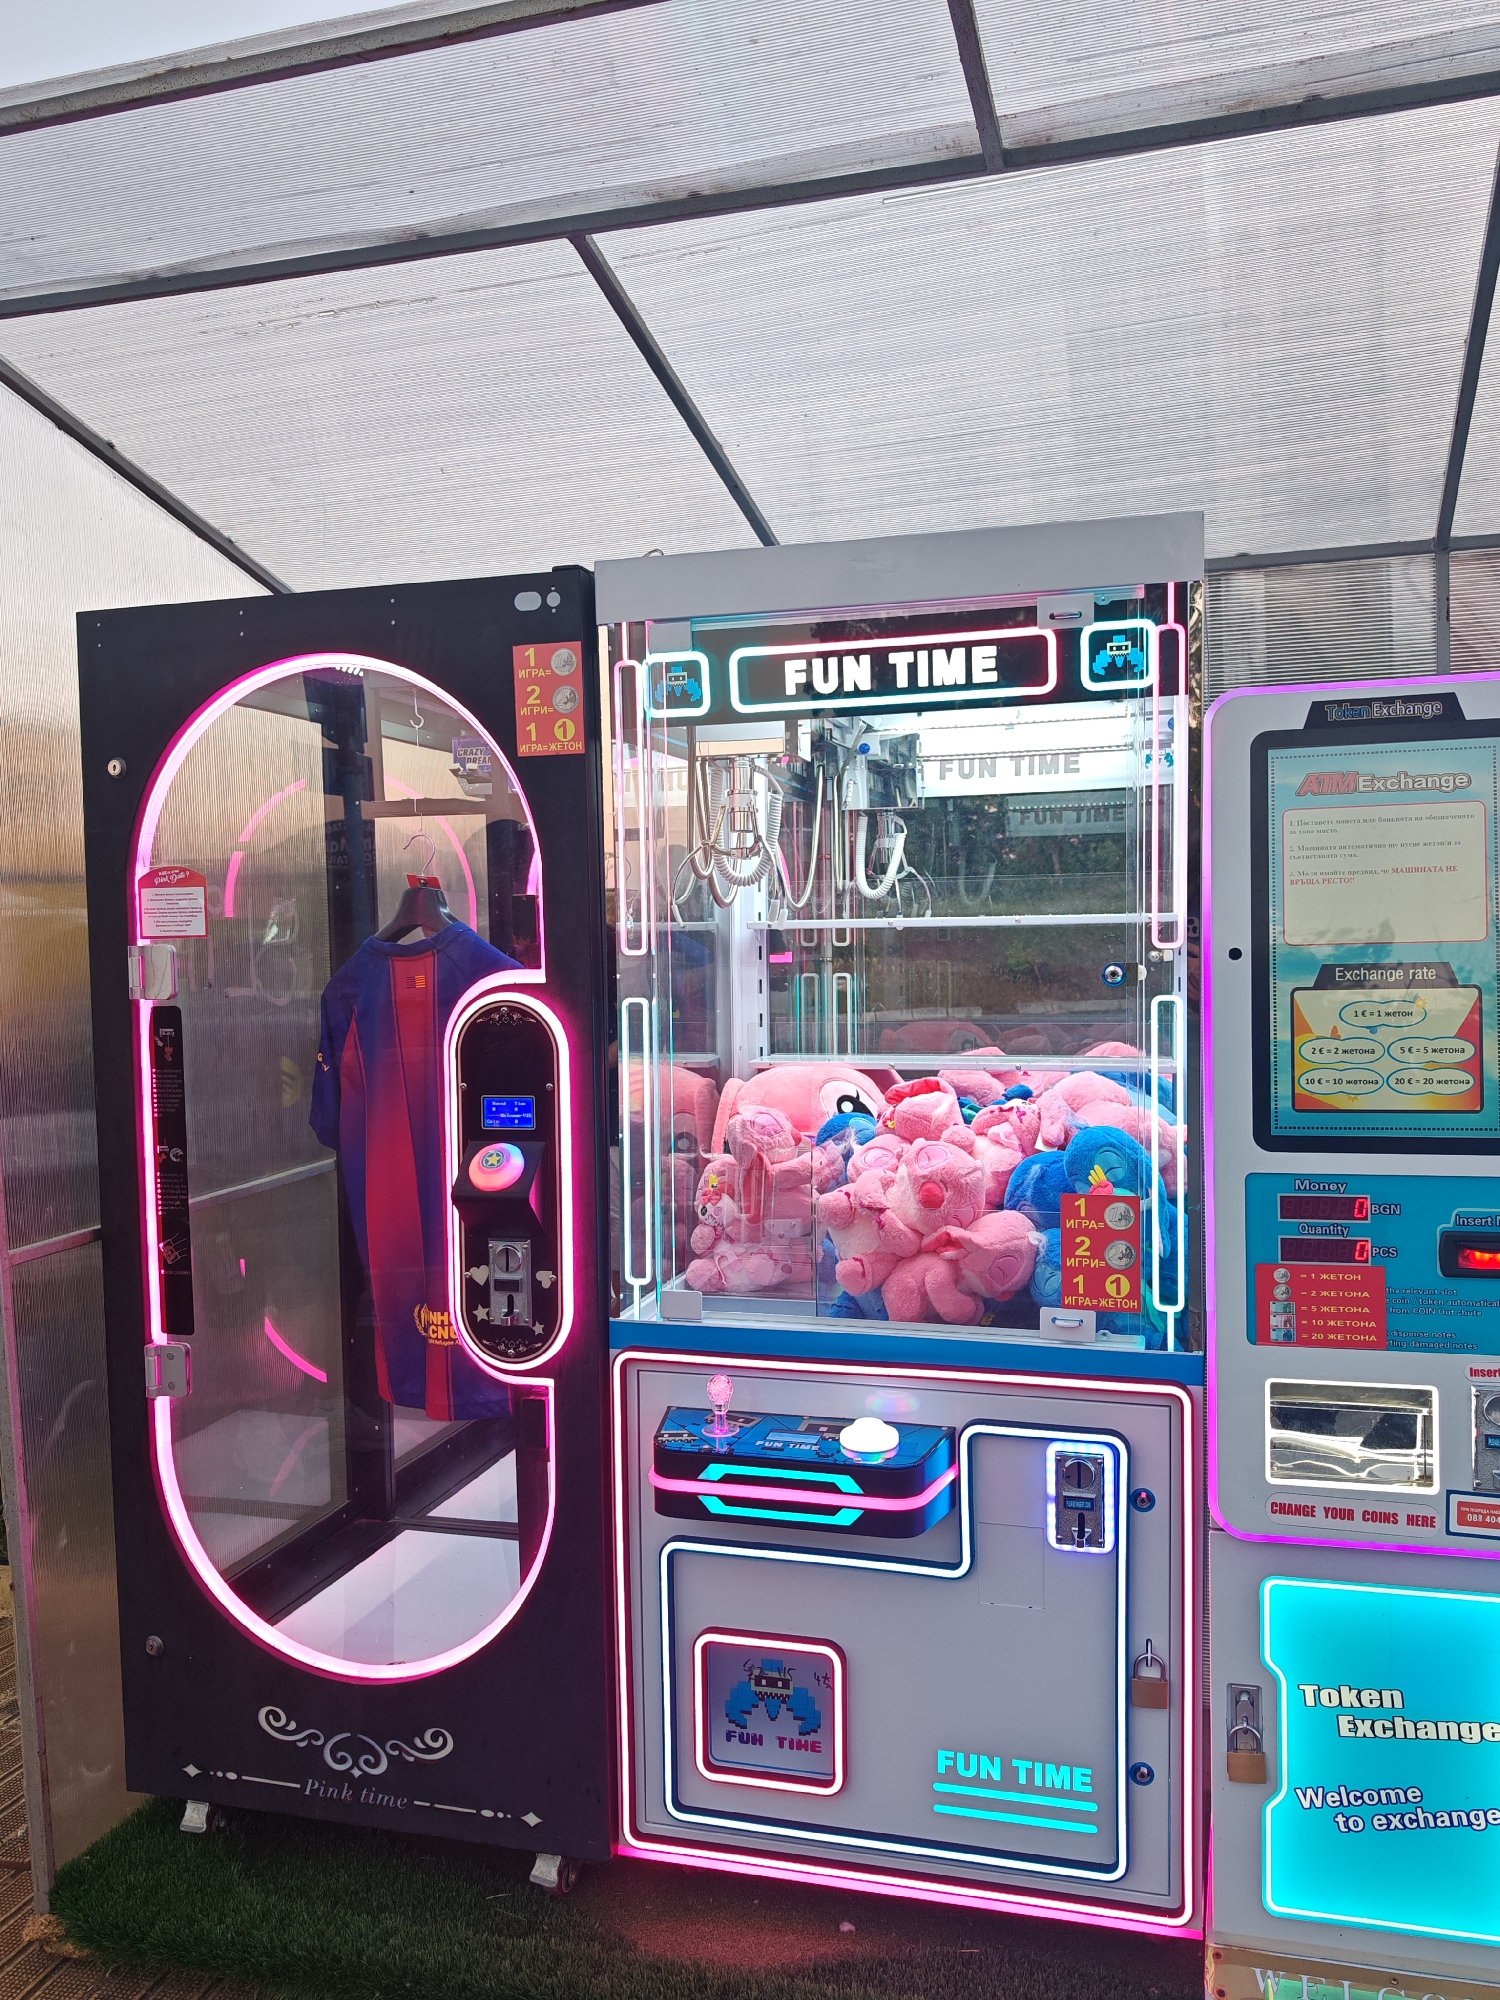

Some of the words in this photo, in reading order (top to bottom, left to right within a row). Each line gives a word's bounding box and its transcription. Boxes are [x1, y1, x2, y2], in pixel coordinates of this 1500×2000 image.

[524, 648, 535, 667] 1
[784, 654, 872, 696] FUN
[888, 645, 998, 689] TIME
[526, 685, 541, 705] 2
[1325, 703, 1371, 721] Token
[1372, 700, 1443, 719] Exchange
[526, 722, 537, 742] 1
[557, 720, 568, 741] 1
[457, 747, 485, 757] CRAZY
[939, 757, 997, 780] FUN
[1010, 753, 1080, 776] TIME
[1019, 809, 1063, 826] FUN
[1070, 807, 1125, 823] TIME
[1391, 866, 1443, 874] МАШИНАТА
[1290, 878, 1320, 886] ВРЪЩА
[1335, 967, 1404, 982] Exchange
[1409, 966, 1437, 980] rate
[1353, 1010, 1359, 1018] 1
[1361, 1010, 1368, 1018] €
[1377, 1010, 1382, 1018] 1
[1311, 1047, 1316, 1055] 2
[1319, 1047, 1325, 1055] €
[1333, 1047, 1339, 1055] 2
[1400, 1046, 1405, 1054] 5
[1408, 1046, 1414, 1054] €
[1423, 1046, 1429, 1054] 5
[1295, 1179, 1347, 1194] Money
[1074, 1198, 1086, 1217] 1
[1354, 1199, 1368, 1218] 0
[1371, 1204, 1401, 1215] BGN
[1456, 1214, 1493, 1226] Insert
[1299, 1223, 1349, 1238] Quantity
[1074, 1236, 1091, 1256] 2
[1354, 1241, 1370, 1260] 0
[1372, 1247, 1398, 1258] PCS
[1072, 1274, 1084, 1294] 1
[1109, 1276, 1122, 1297] 1
[1402, 1287, 1438, 1295] relevant
[1440, 1288, 1457, 1296] slot
[1320, 1290, 1370, 1298] ЖЕТОНА
[1419, 1298, 1444, 1306] token
[430, 1311, 451, 1325] NH
[1413, 1307, 1436, 1315] COIN
[1326, 1320, 1377, 1328] ЖЕТОНА
[1390, 1329, 1429, 1338] dispense
[1410, 1340, 1450, 1349] damaged
[1453, 1342, 1478, 1350] notes
[788, 1443, 820, 1451] TIME
[1270, 1502, 1316, 1518] CHANGE
[1323, 1506, 1355, 1521] YOUR
[1361, 1510, 1399, 1525] COINS
[1406, 1513, 1436, 1529] HERE
[1298, 1684, 1404, 1709] Token
[1337, 1714, 1500, 1744] Exchange
[726, 1730, 763, 1746] FUN
[775, 1735, 822, 1753] TIME
[938, 1750, 1001, 1781] FUN
[1012, 1759, 1092, 1793] TIME
[304, 1779, 353, 1801] Pink
[360, 1787, 408, 1809] time
[1294, 1785, 1423, 1809] Welcome
[1334, 1812, 1365, 1833] to
[1372, 1807, 1500, 1831] exchange
